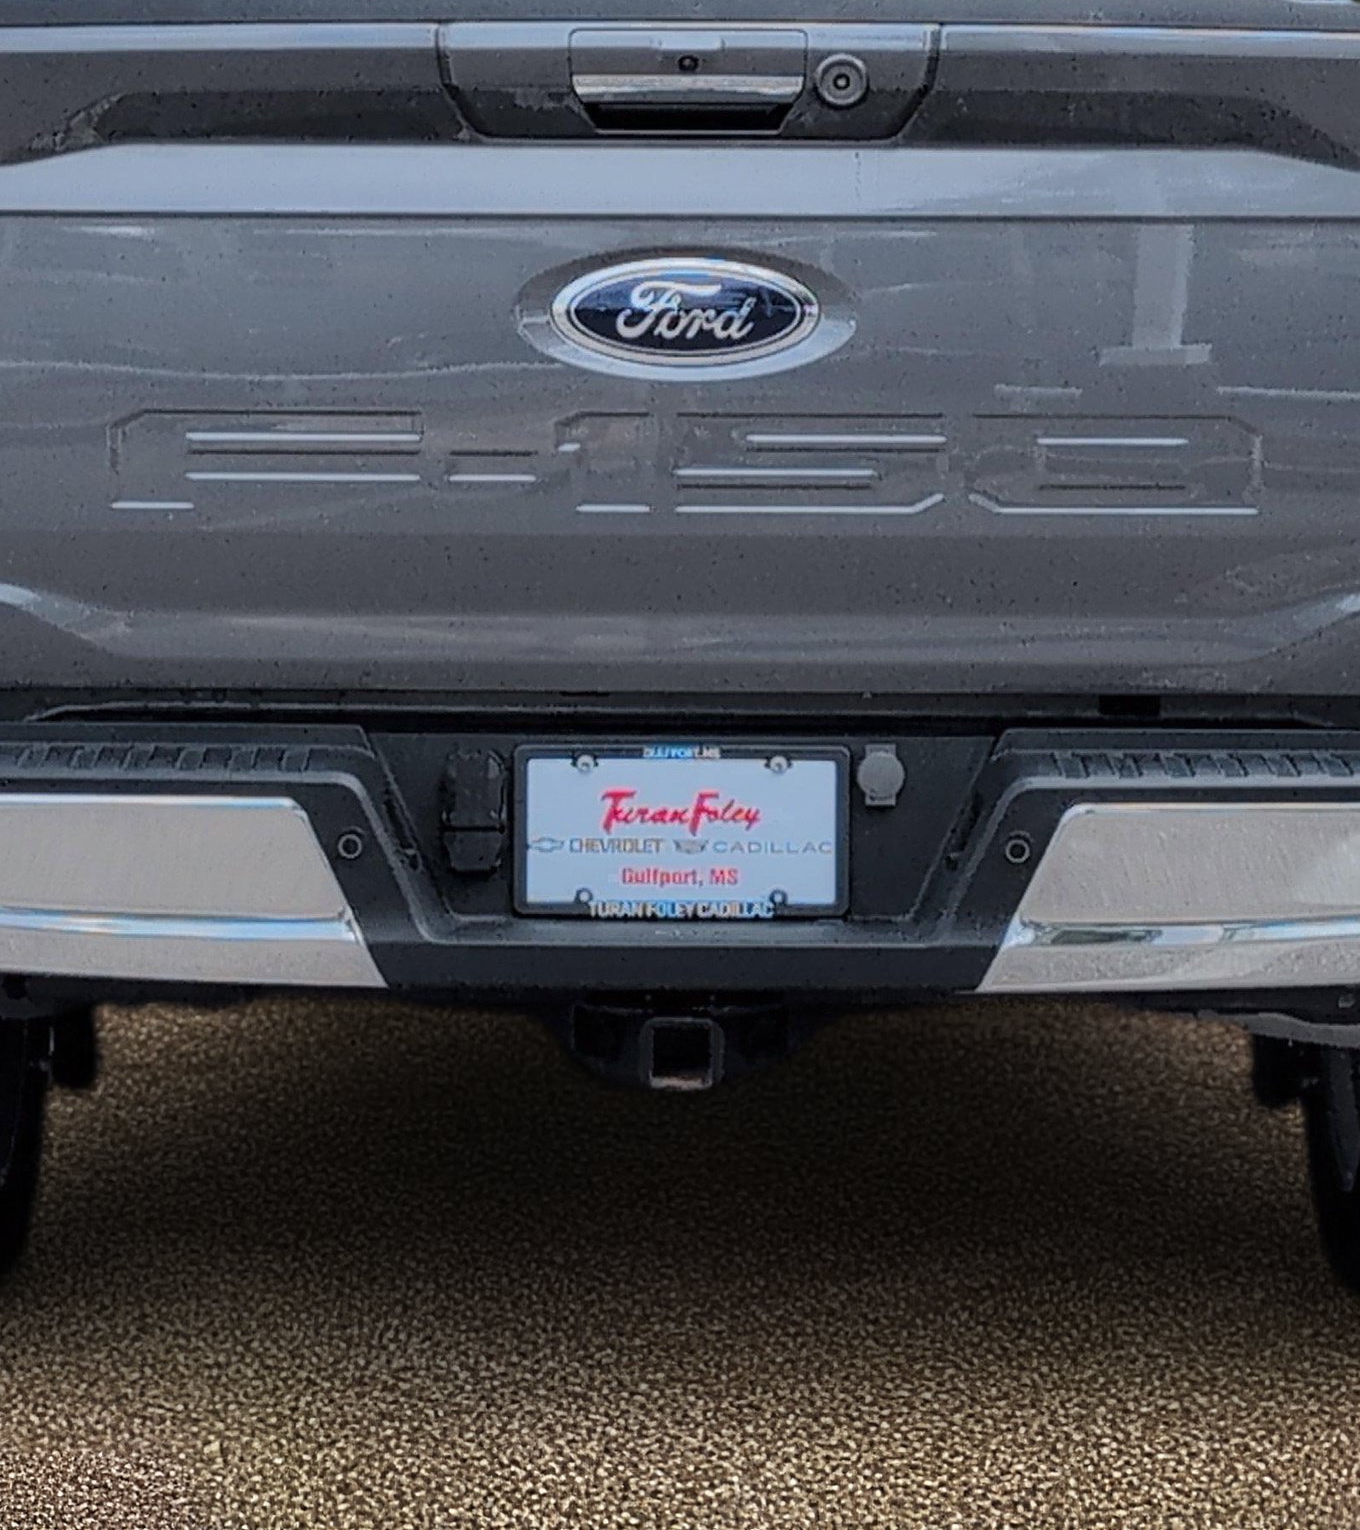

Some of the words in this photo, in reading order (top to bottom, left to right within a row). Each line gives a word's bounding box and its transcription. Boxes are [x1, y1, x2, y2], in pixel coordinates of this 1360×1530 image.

[615, 280, 758, 340] Ford
[569, 837, 664, 854] CHEVROLET
[712, 840, 833, 854] CADILLAC
[621, 867, 704, 887] Gulfport,
[709, 867, 739, 884] MS
[697, 900, 775, 918] CADILLAC
